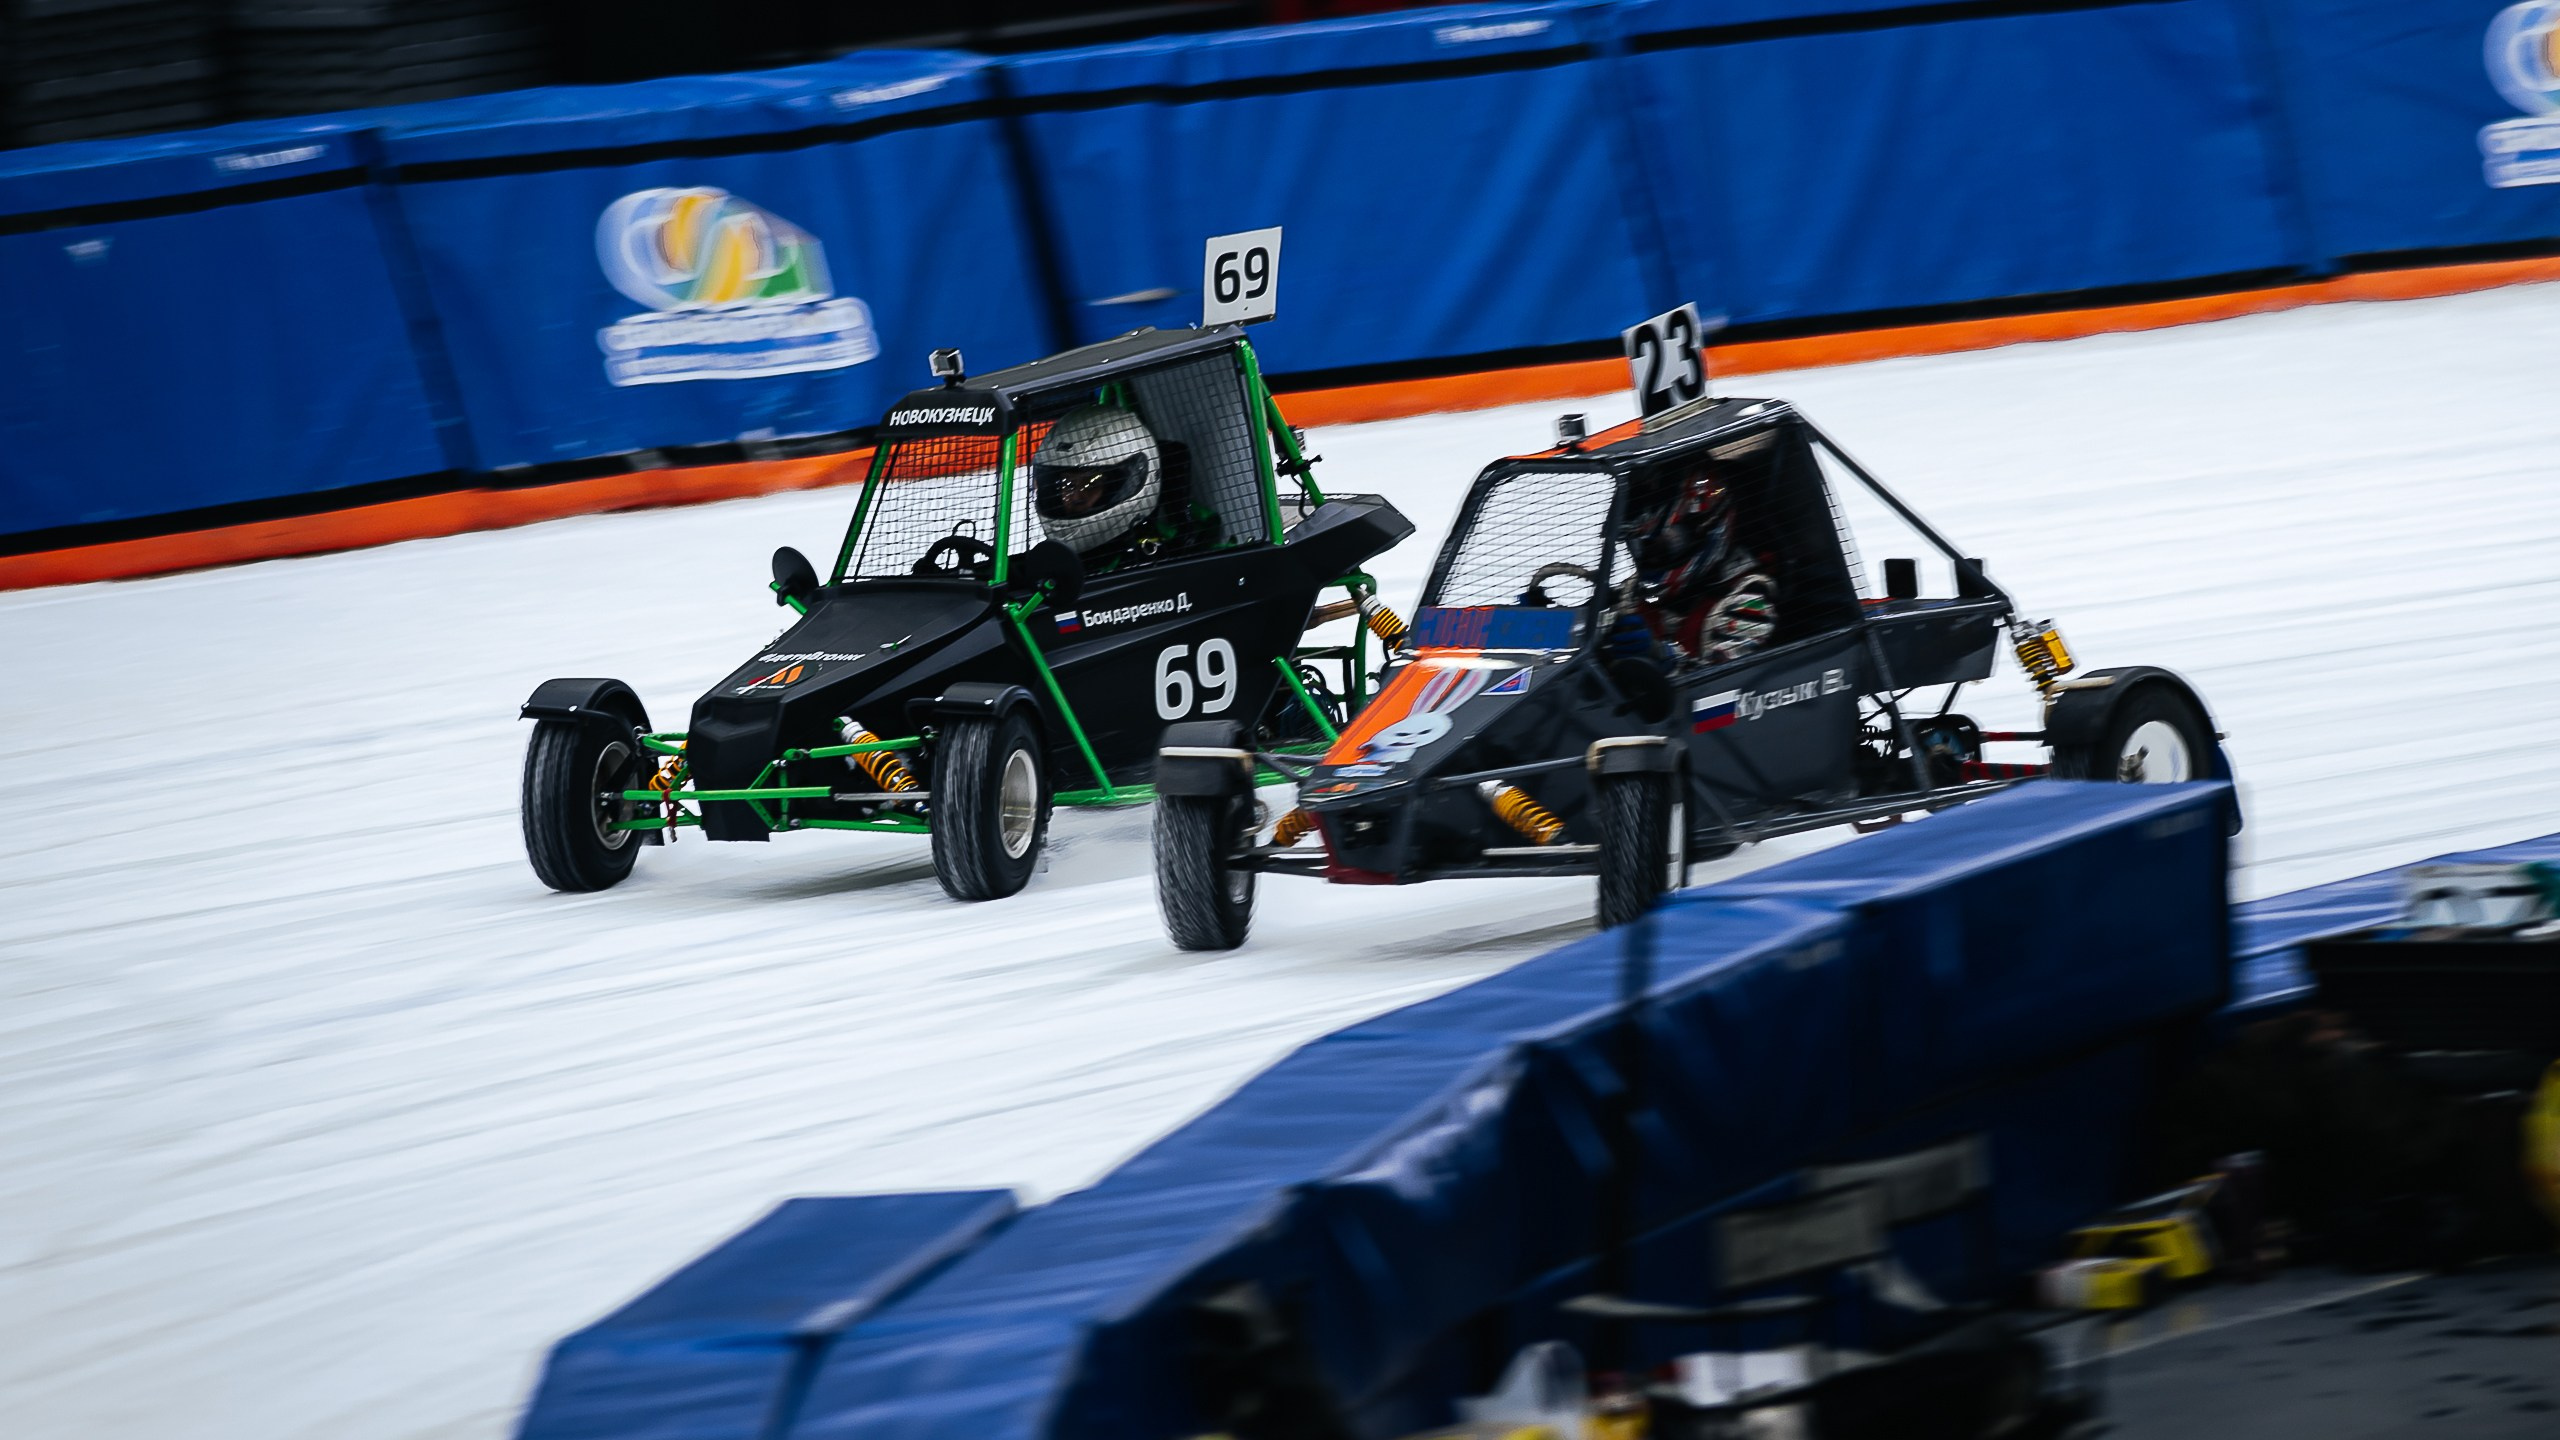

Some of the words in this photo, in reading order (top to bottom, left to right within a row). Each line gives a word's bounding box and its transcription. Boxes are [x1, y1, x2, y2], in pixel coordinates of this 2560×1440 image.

[1213, 246, 1270, 304] 69
[1631, 309, 1705, 417] 23
[889, 406, 996, 426] НОВОКУЗНЕЦК
[1081, 598, 1174, 628] Бондаренко
[1177, 592, 1193, 613] Д.
[1154, 637, 1238, 721] 69
